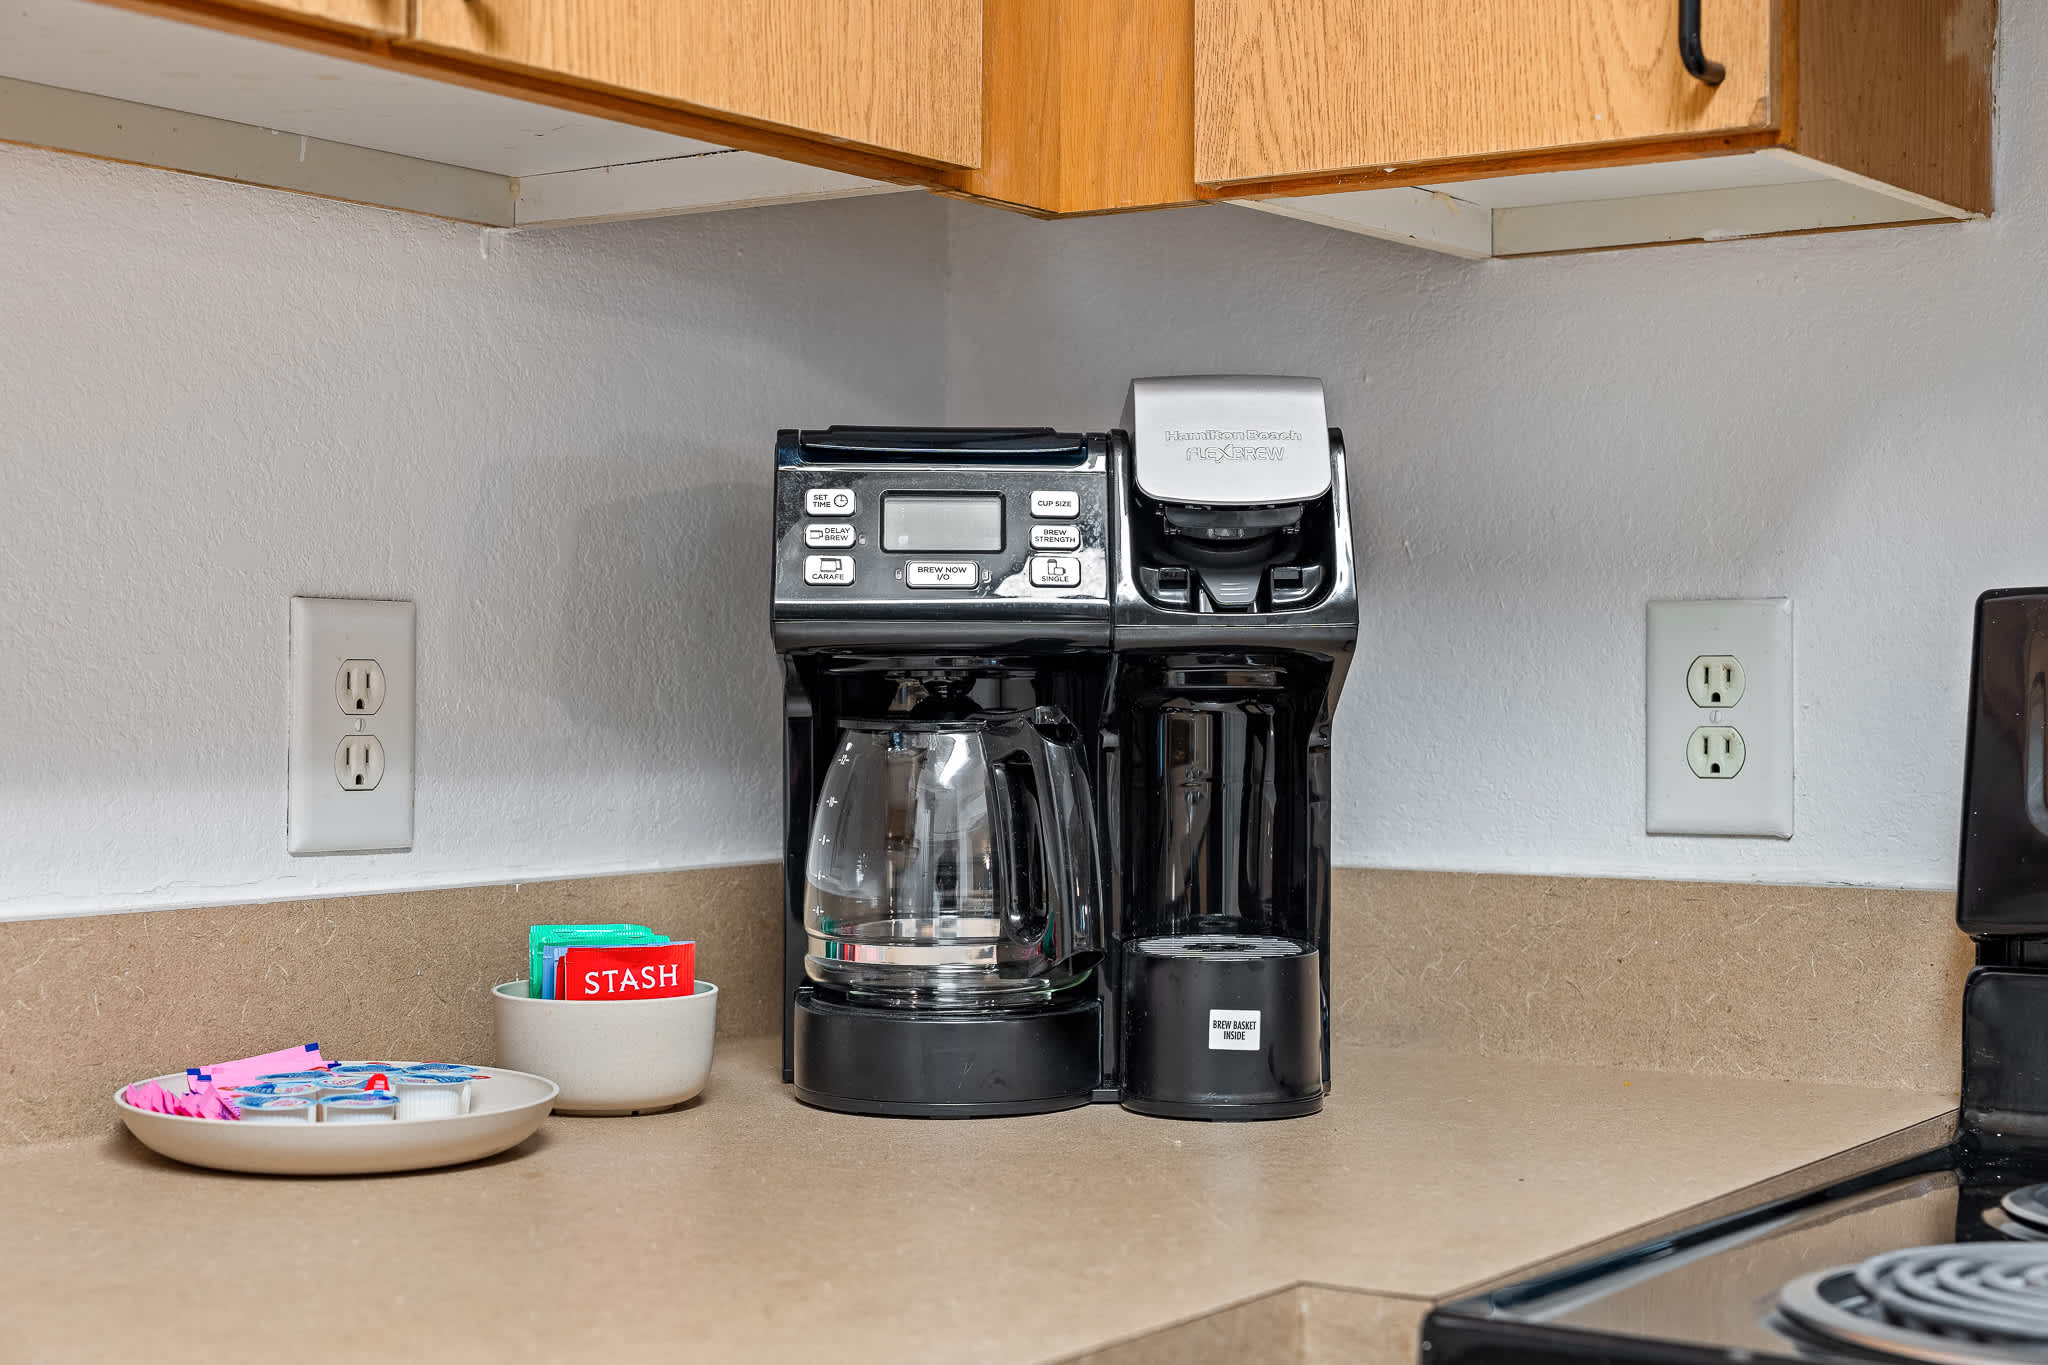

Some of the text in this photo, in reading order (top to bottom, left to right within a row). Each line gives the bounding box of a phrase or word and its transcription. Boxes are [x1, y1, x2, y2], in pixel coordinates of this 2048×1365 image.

[1164, 429, 1303, 442] Hamilton Beach
[945, 566, 967, 574] NOW
[584, 964, 678, 995] STASH
[1212, 1020, 1257, 1030] BREW BASKET
[1223, 1030, 1246, 1040] INSIDE
